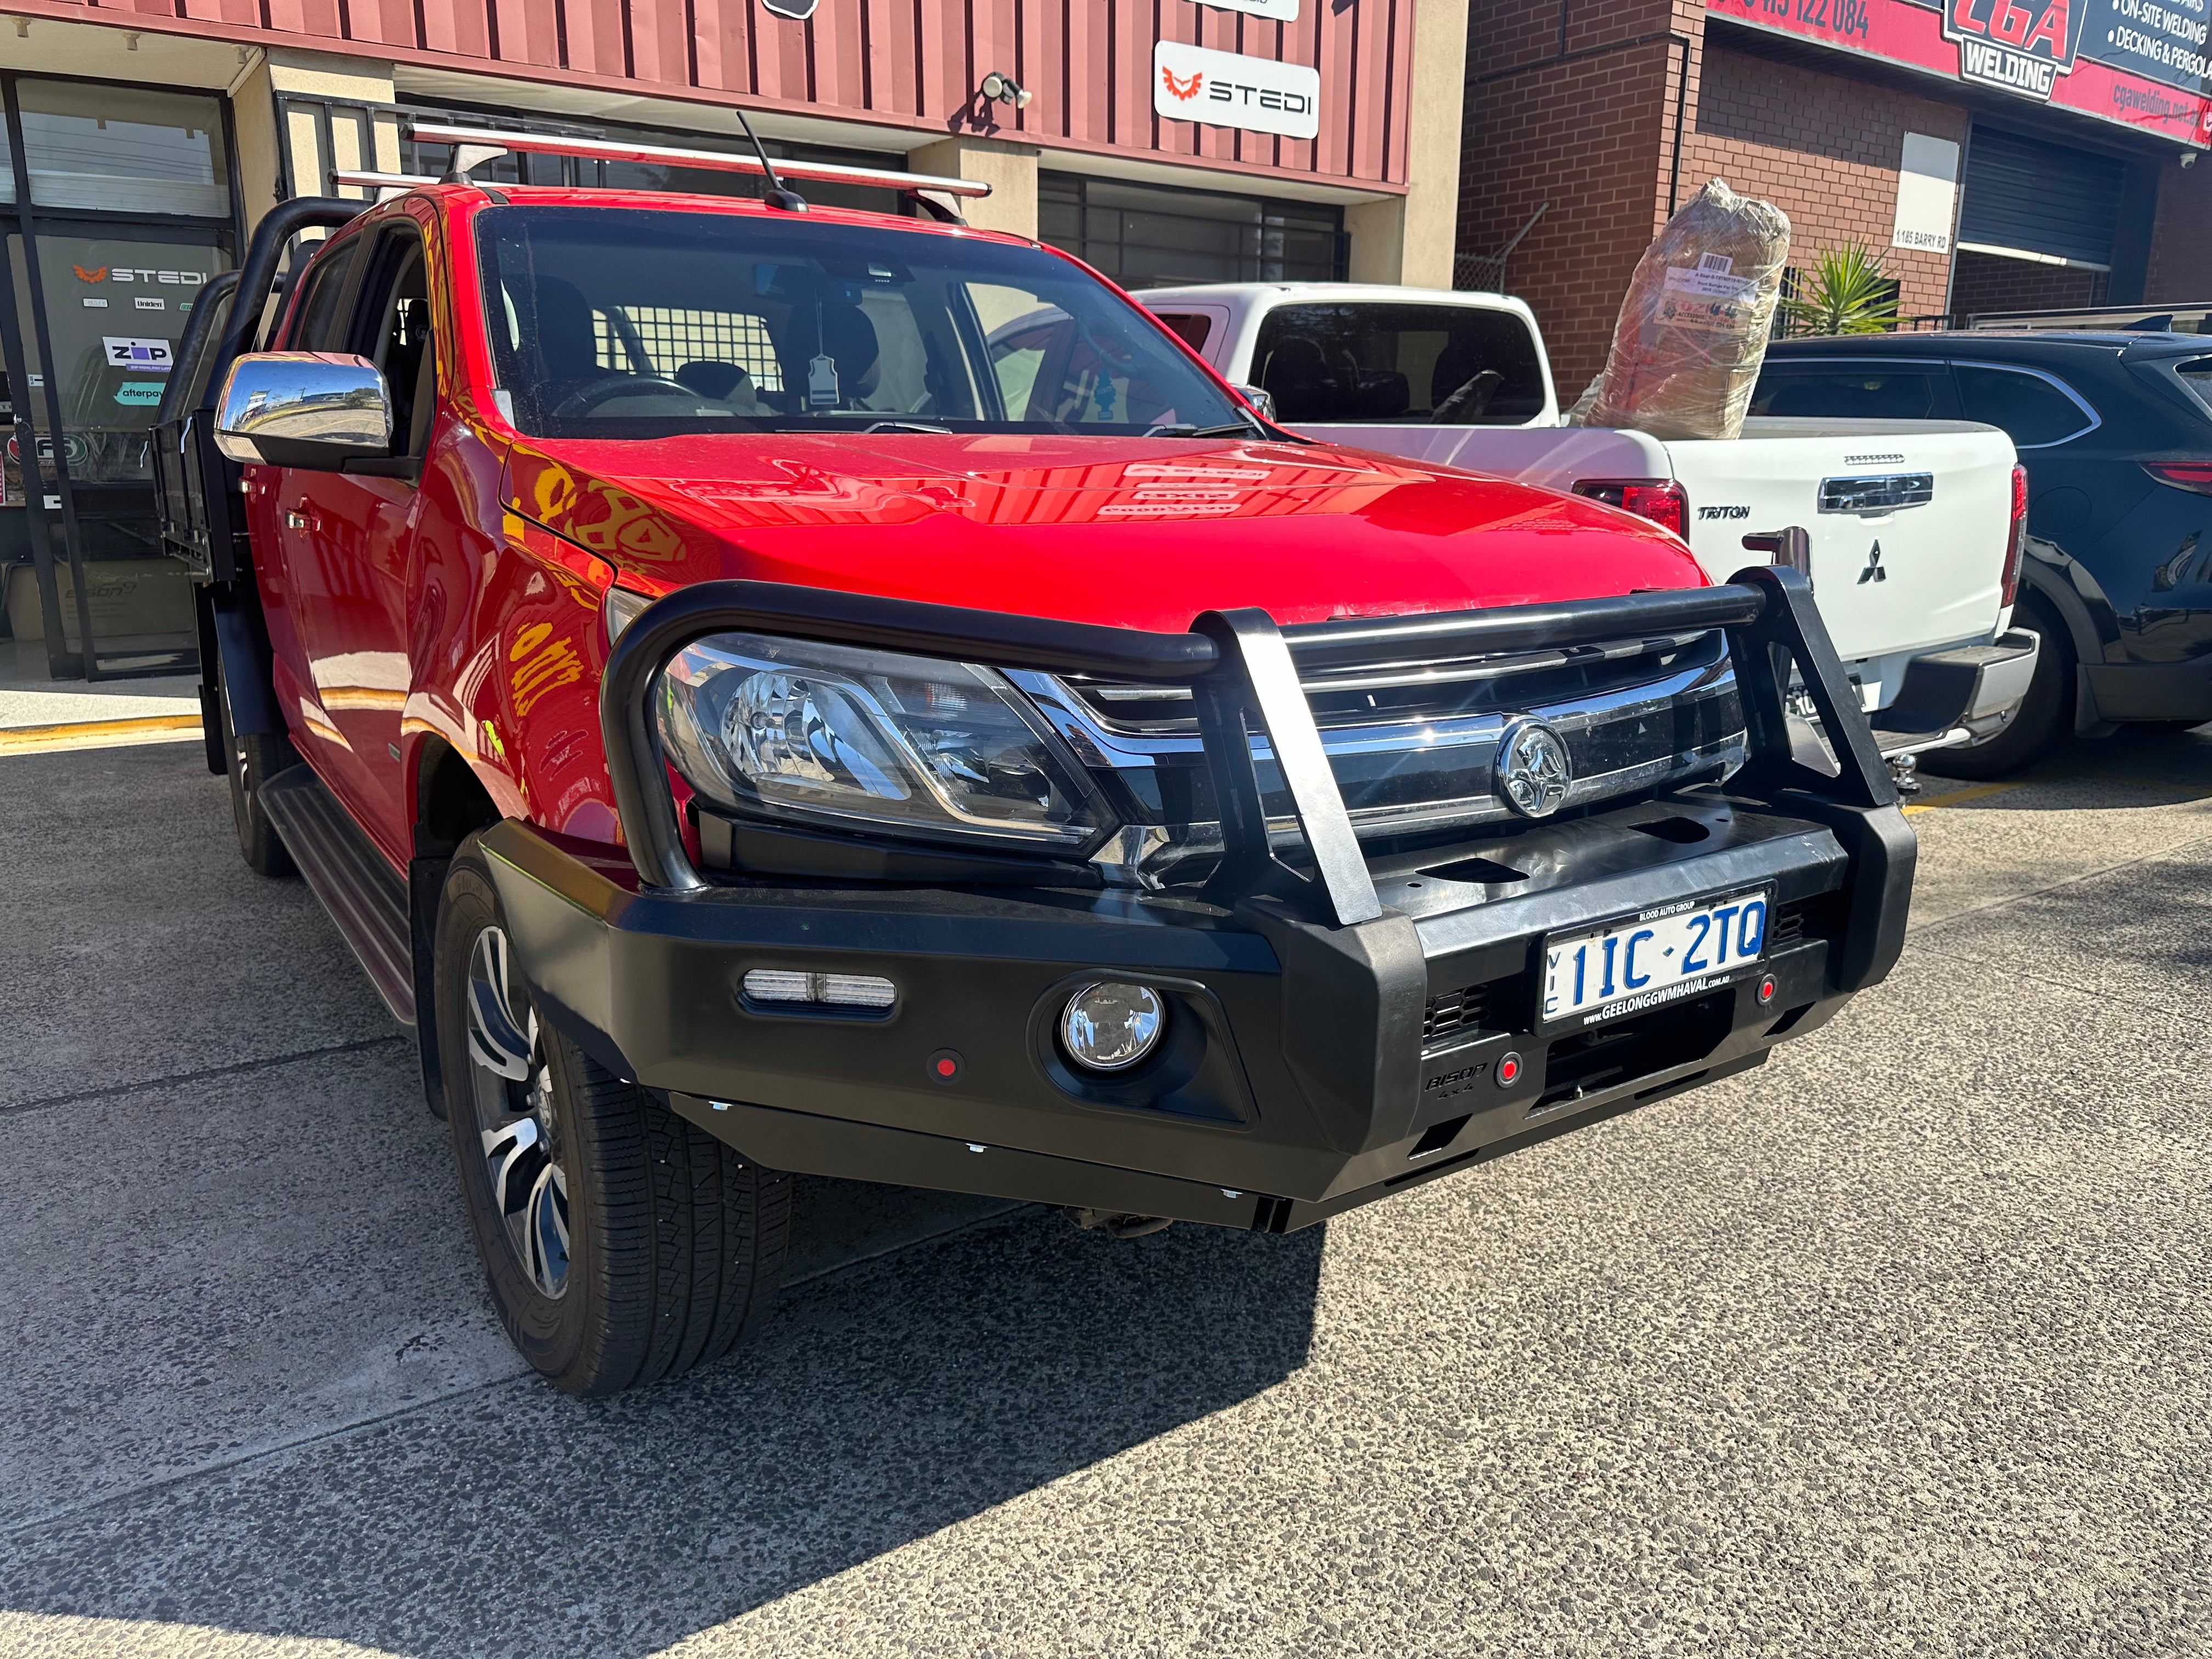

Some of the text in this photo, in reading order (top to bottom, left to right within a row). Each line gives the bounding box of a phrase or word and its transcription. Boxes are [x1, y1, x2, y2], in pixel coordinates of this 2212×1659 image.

[1832, 0, 1868, 39] 084
[1954, 0, 2069, 60] CGA
[2121, 0, 2207, 46] ON-SITE WELDING
[2115, 25, 2163, 61] DECKING
[2162, 43, 2170, 64] &
[1966, 42, 2052, 92] WELDING
[1210, 80, 1311, 115] STEDI
[1915, 232, 1936, 247] BARRY
[1937, 236, 1946, 249] RD
[111, 268, 208, 285] STEDI
[137, 298, 162, 308] Uniden
[1697, 506, 1750, 520] TRITON
[65, 587, 123, 599] BSON
[1639, 900, 1695, 921] BLOOD AUTO GROUP
[1424, 1063, 1488, 1092] BISON
